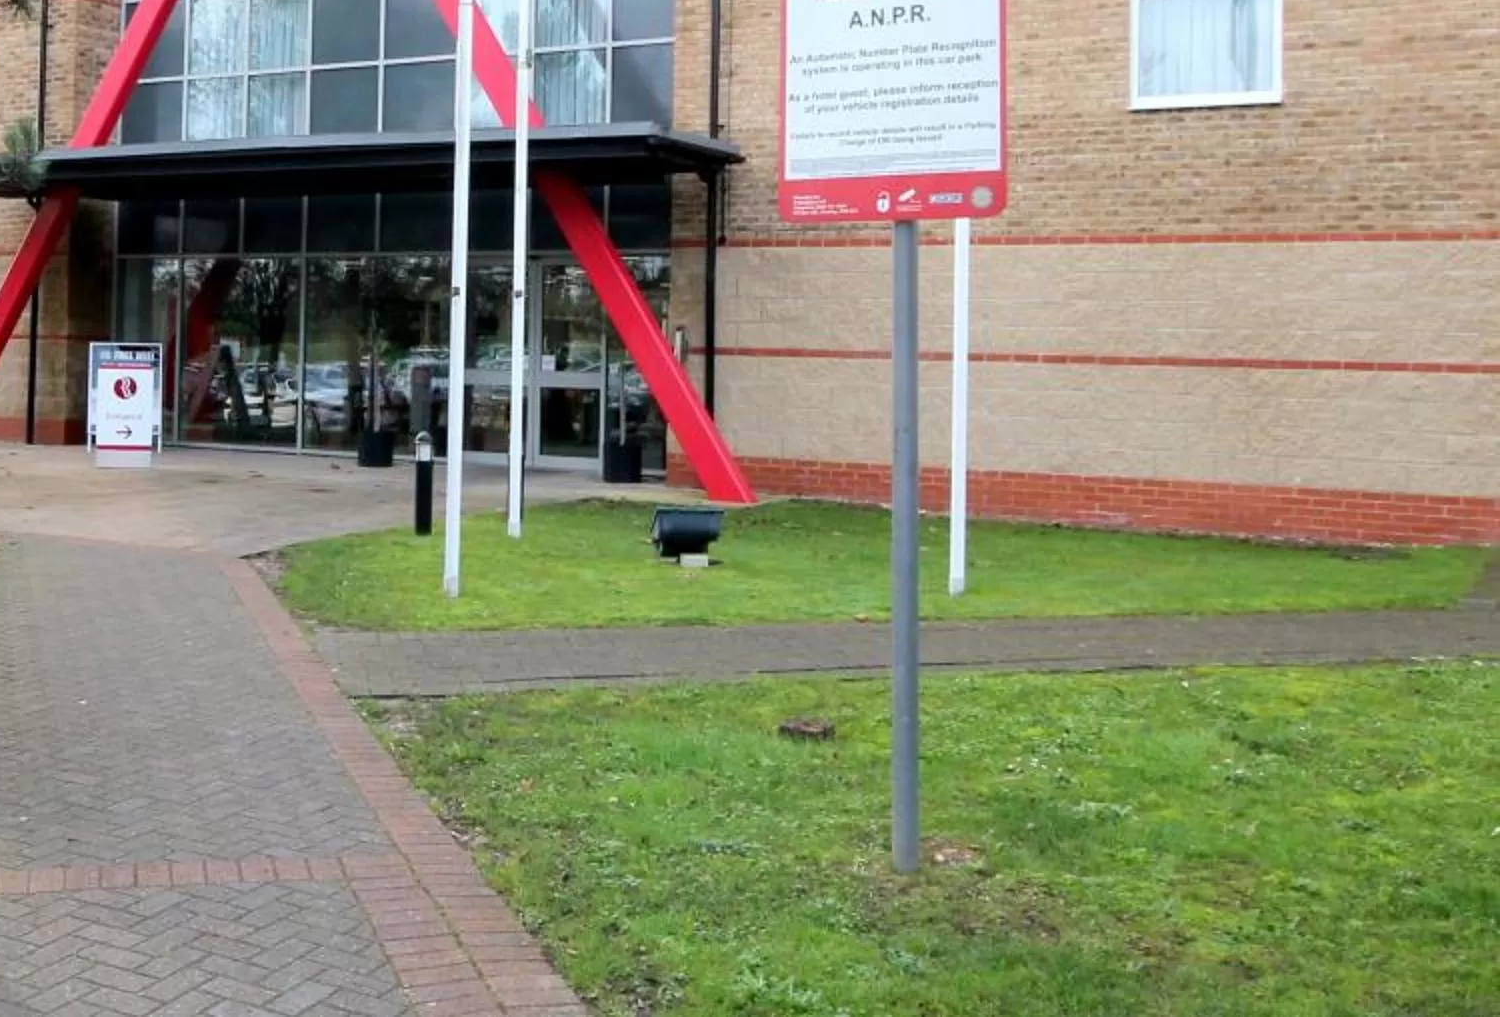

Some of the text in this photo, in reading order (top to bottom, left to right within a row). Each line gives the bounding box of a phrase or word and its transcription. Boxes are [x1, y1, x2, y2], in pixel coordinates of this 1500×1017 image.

[848, 4, 932, 29] A.N.P.R.
[859, 47, 900, 59] Number
[902, 43, 929, 56] Plate
[931, 39, 997, 52] Recognition
[802, 65, 837, 78] system
[851, 59, 901, 73] operating
[915, 56, 935, 67] this
[958, 53, 982, 65] park
[873, 85, 907, 98] please
[909, 82, 944, 94] inform
[947, 79, 998, 91] reception
[842, 100, 878, 112] vehicle
[880, 95, 941, 110] registration
[943, 92, 980, 104] details
